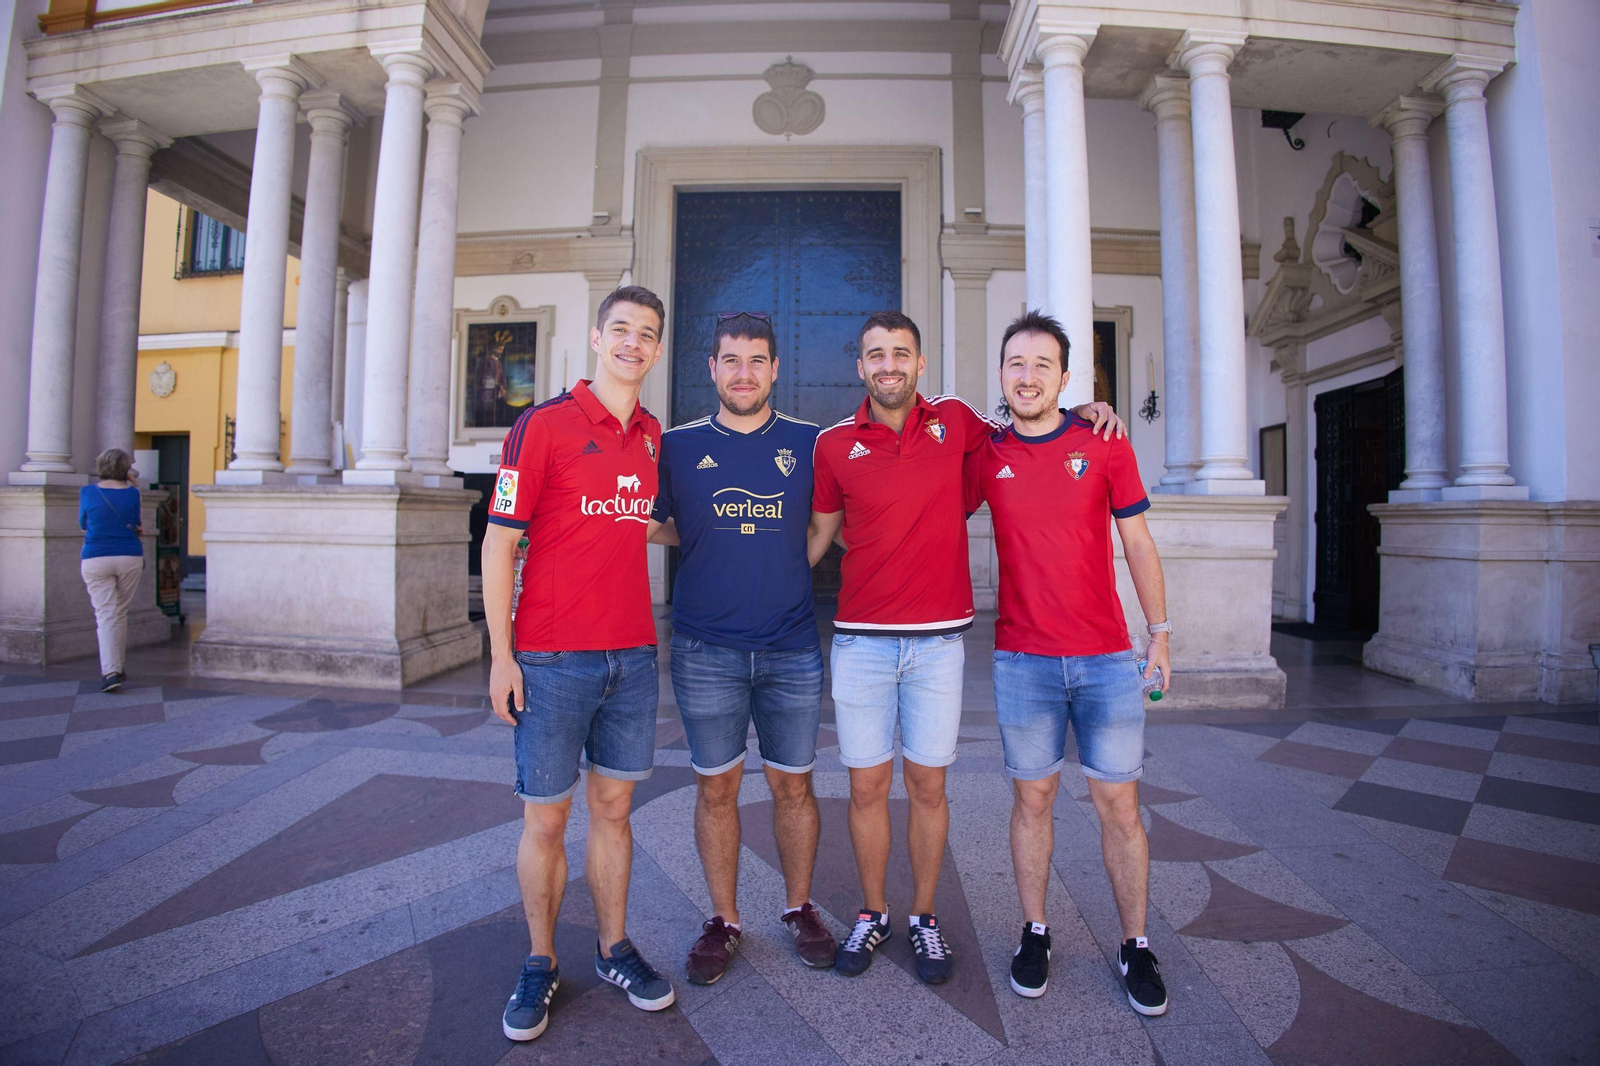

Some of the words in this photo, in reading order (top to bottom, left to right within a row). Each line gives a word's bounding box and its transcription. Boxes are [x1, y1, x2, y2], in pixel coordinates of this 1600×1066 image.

[848, 448, 871, 460] adidas
[495, 498, 513, 512] LFP
[713, 499, 783, 519] verleal
[743, 525, 753, 533] cn
